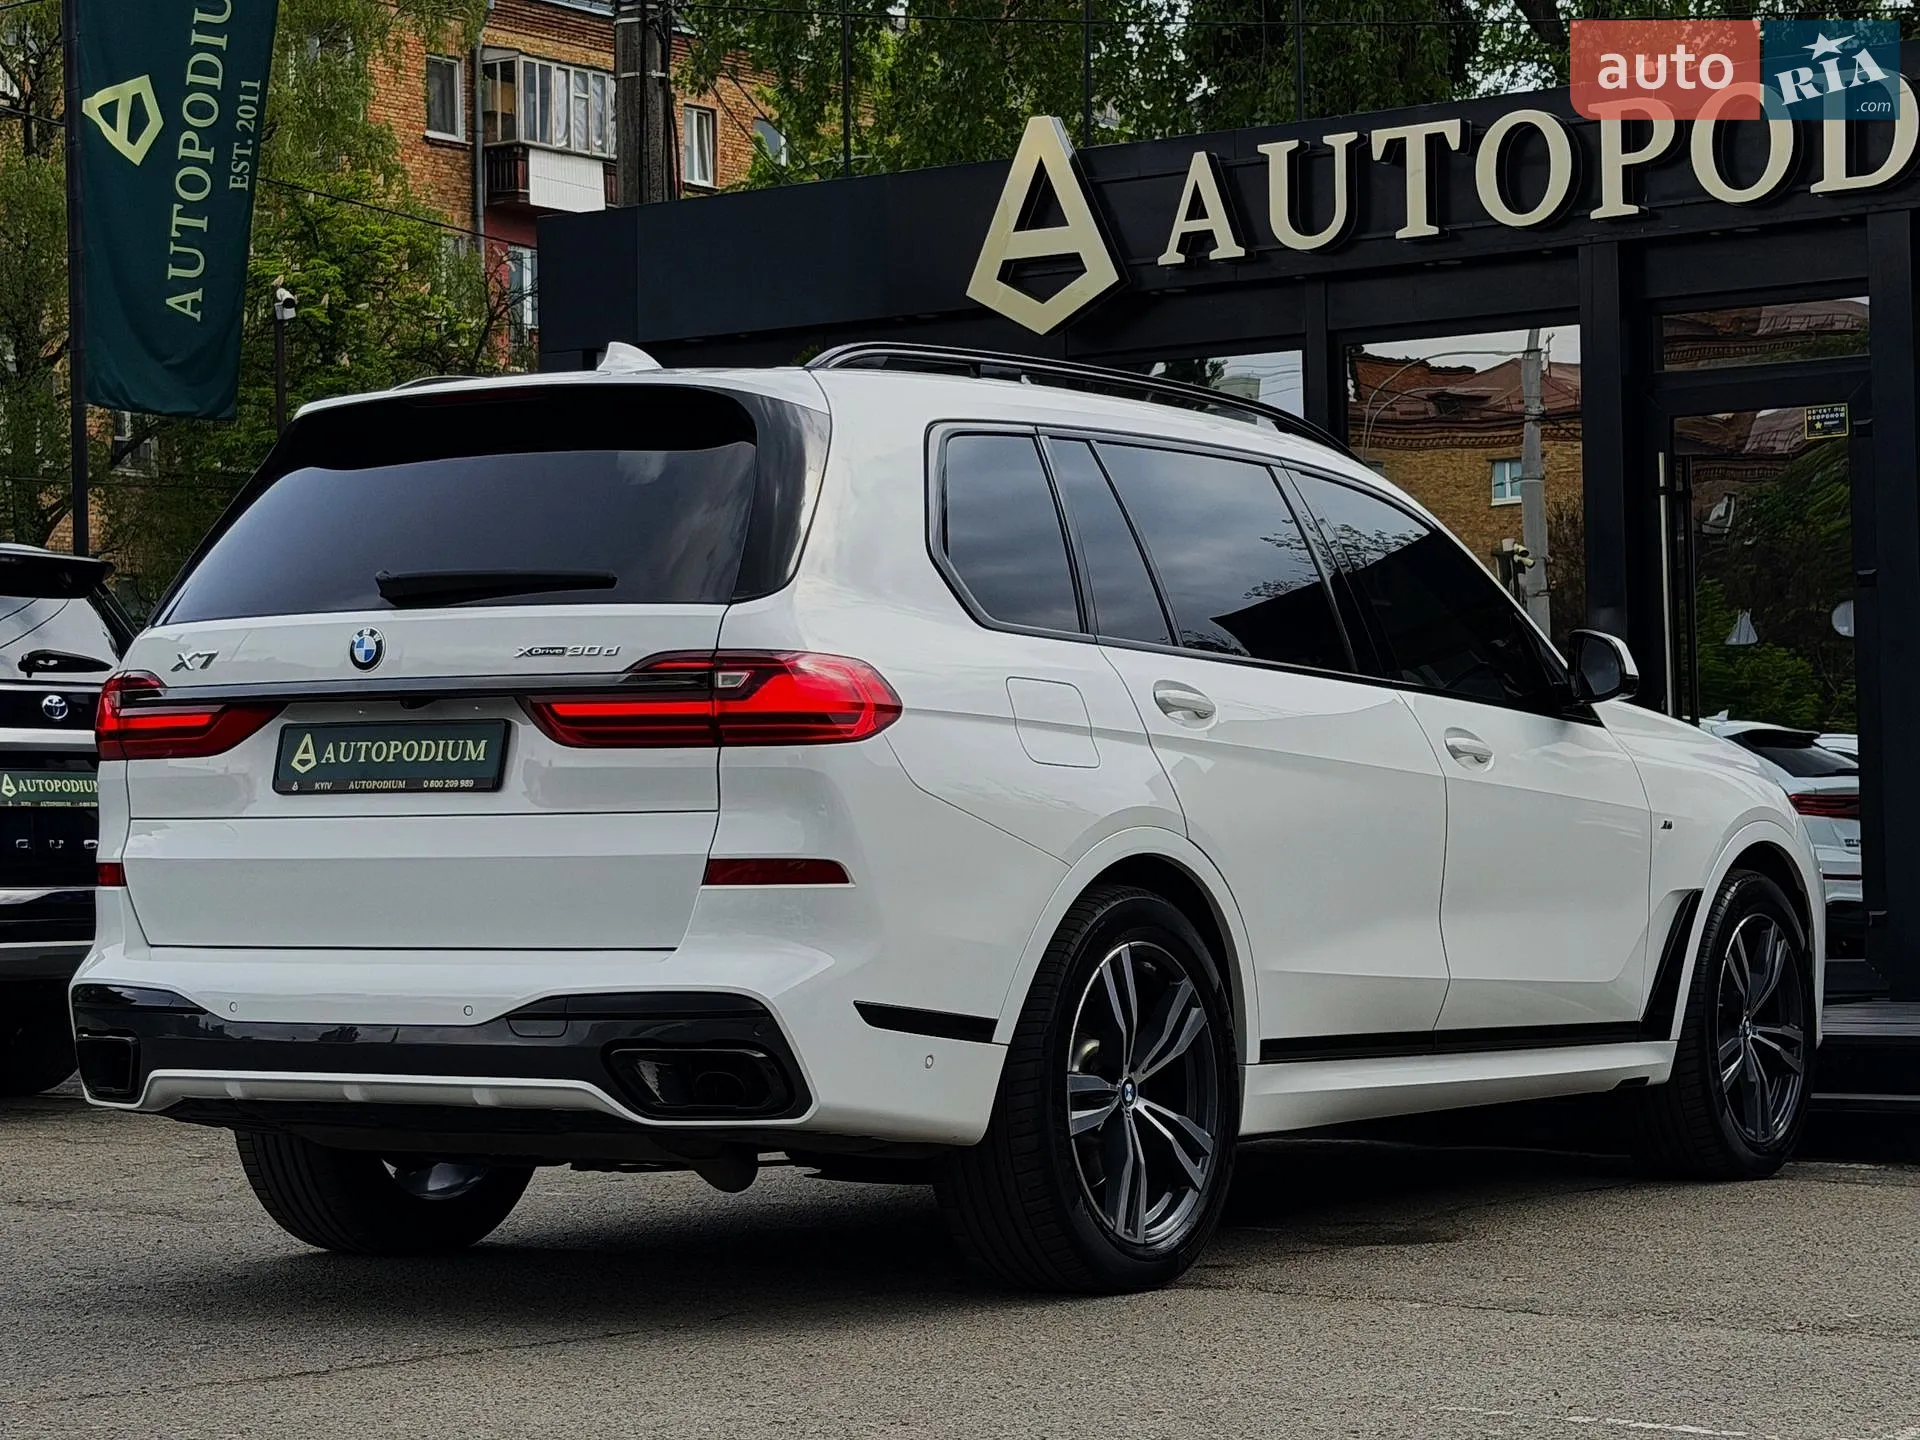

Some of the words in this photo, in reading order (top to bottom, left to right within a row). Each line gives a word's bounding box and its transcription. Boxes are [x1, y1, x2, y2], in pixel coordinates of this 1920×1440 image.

[236, 79, 261, 133] 2011
[165, 0, 233, 322] AUTOPODIU
[229, 138, 254, 192] EST.
[1157, 67, 1919, 266] AUTOPOD
[170, 650, 220, 672] X7
[321, 739, 488, 764] AUTOPODIUM
[314, 782, 333, 790] KYIV
[348, 780, 406, 790] AUTOPODIUM
